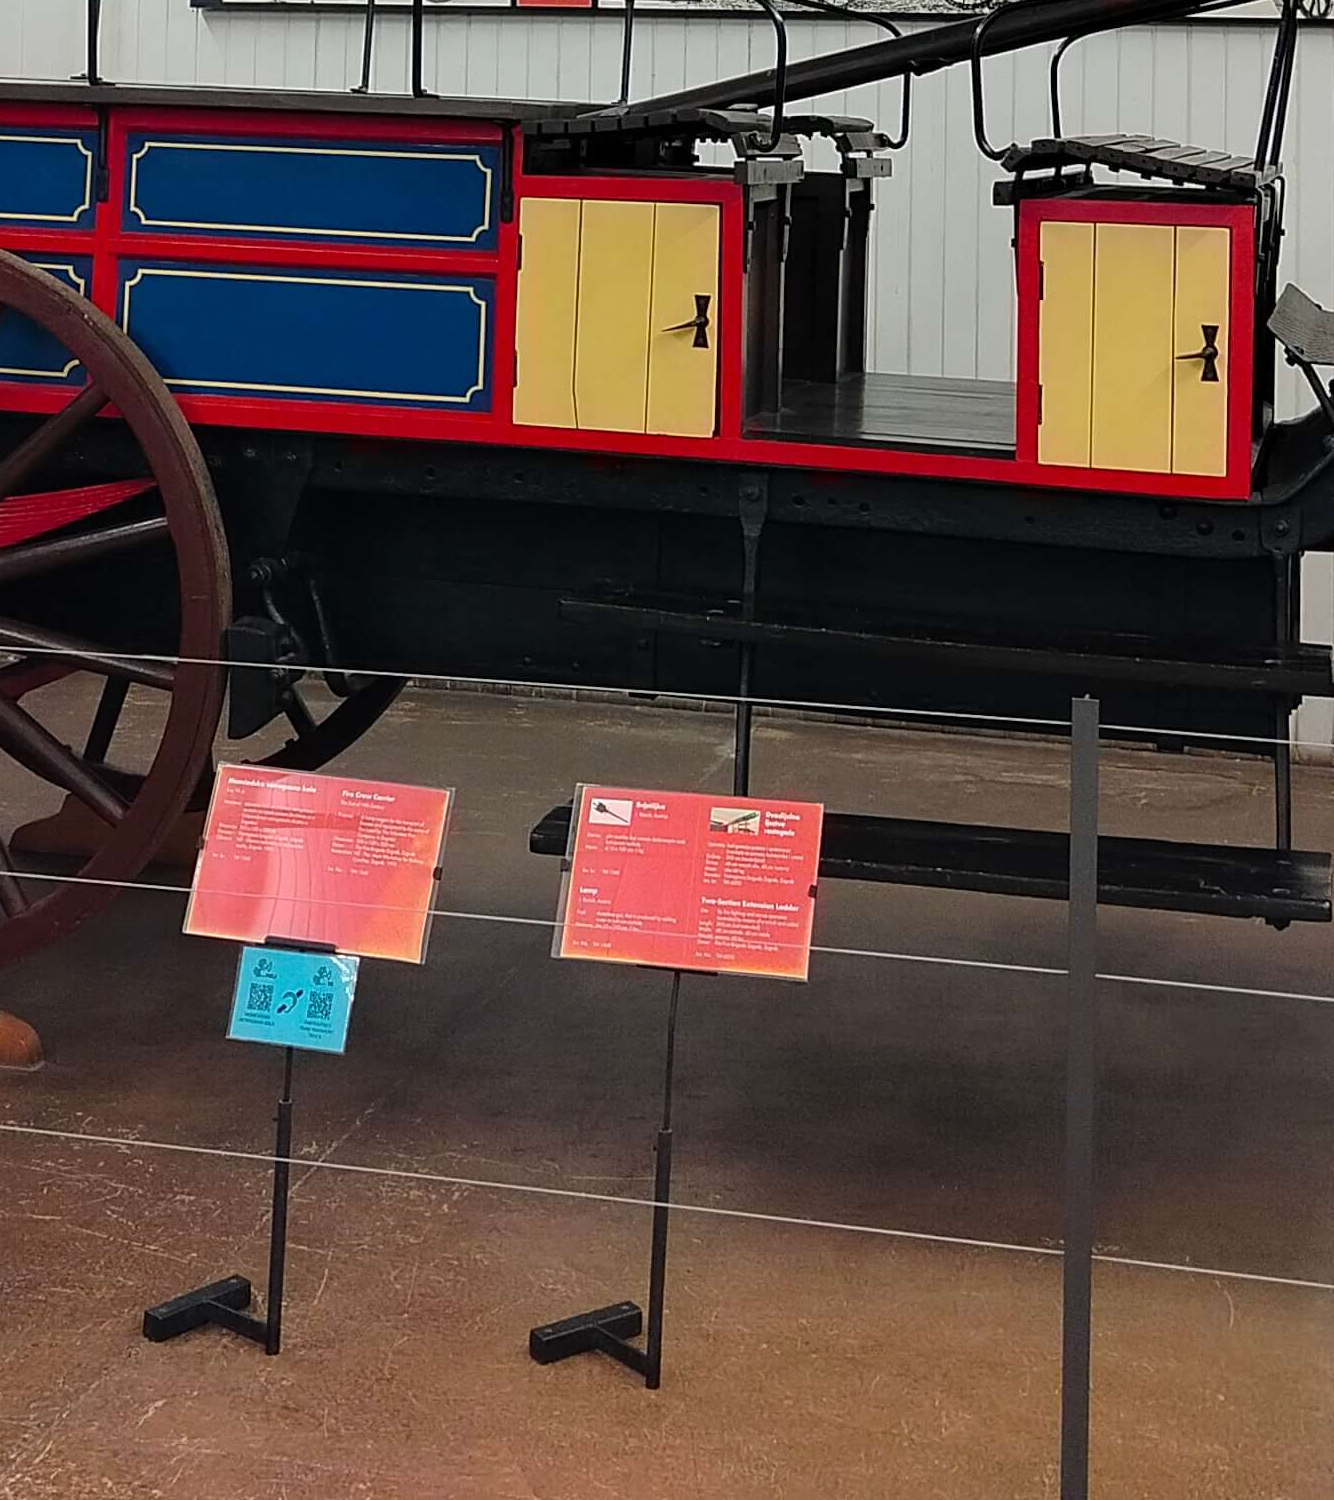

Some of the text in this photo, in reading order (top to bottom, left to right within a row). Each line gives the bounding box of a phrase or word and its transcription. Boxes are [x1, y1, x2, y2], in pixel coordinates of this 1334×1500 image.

[342, 789, 396, 802] Fire Crew Carrier
[579, 886, 598, 895] Lamp
[701, 896, 800, 912] Two-Section Extension Ladder
